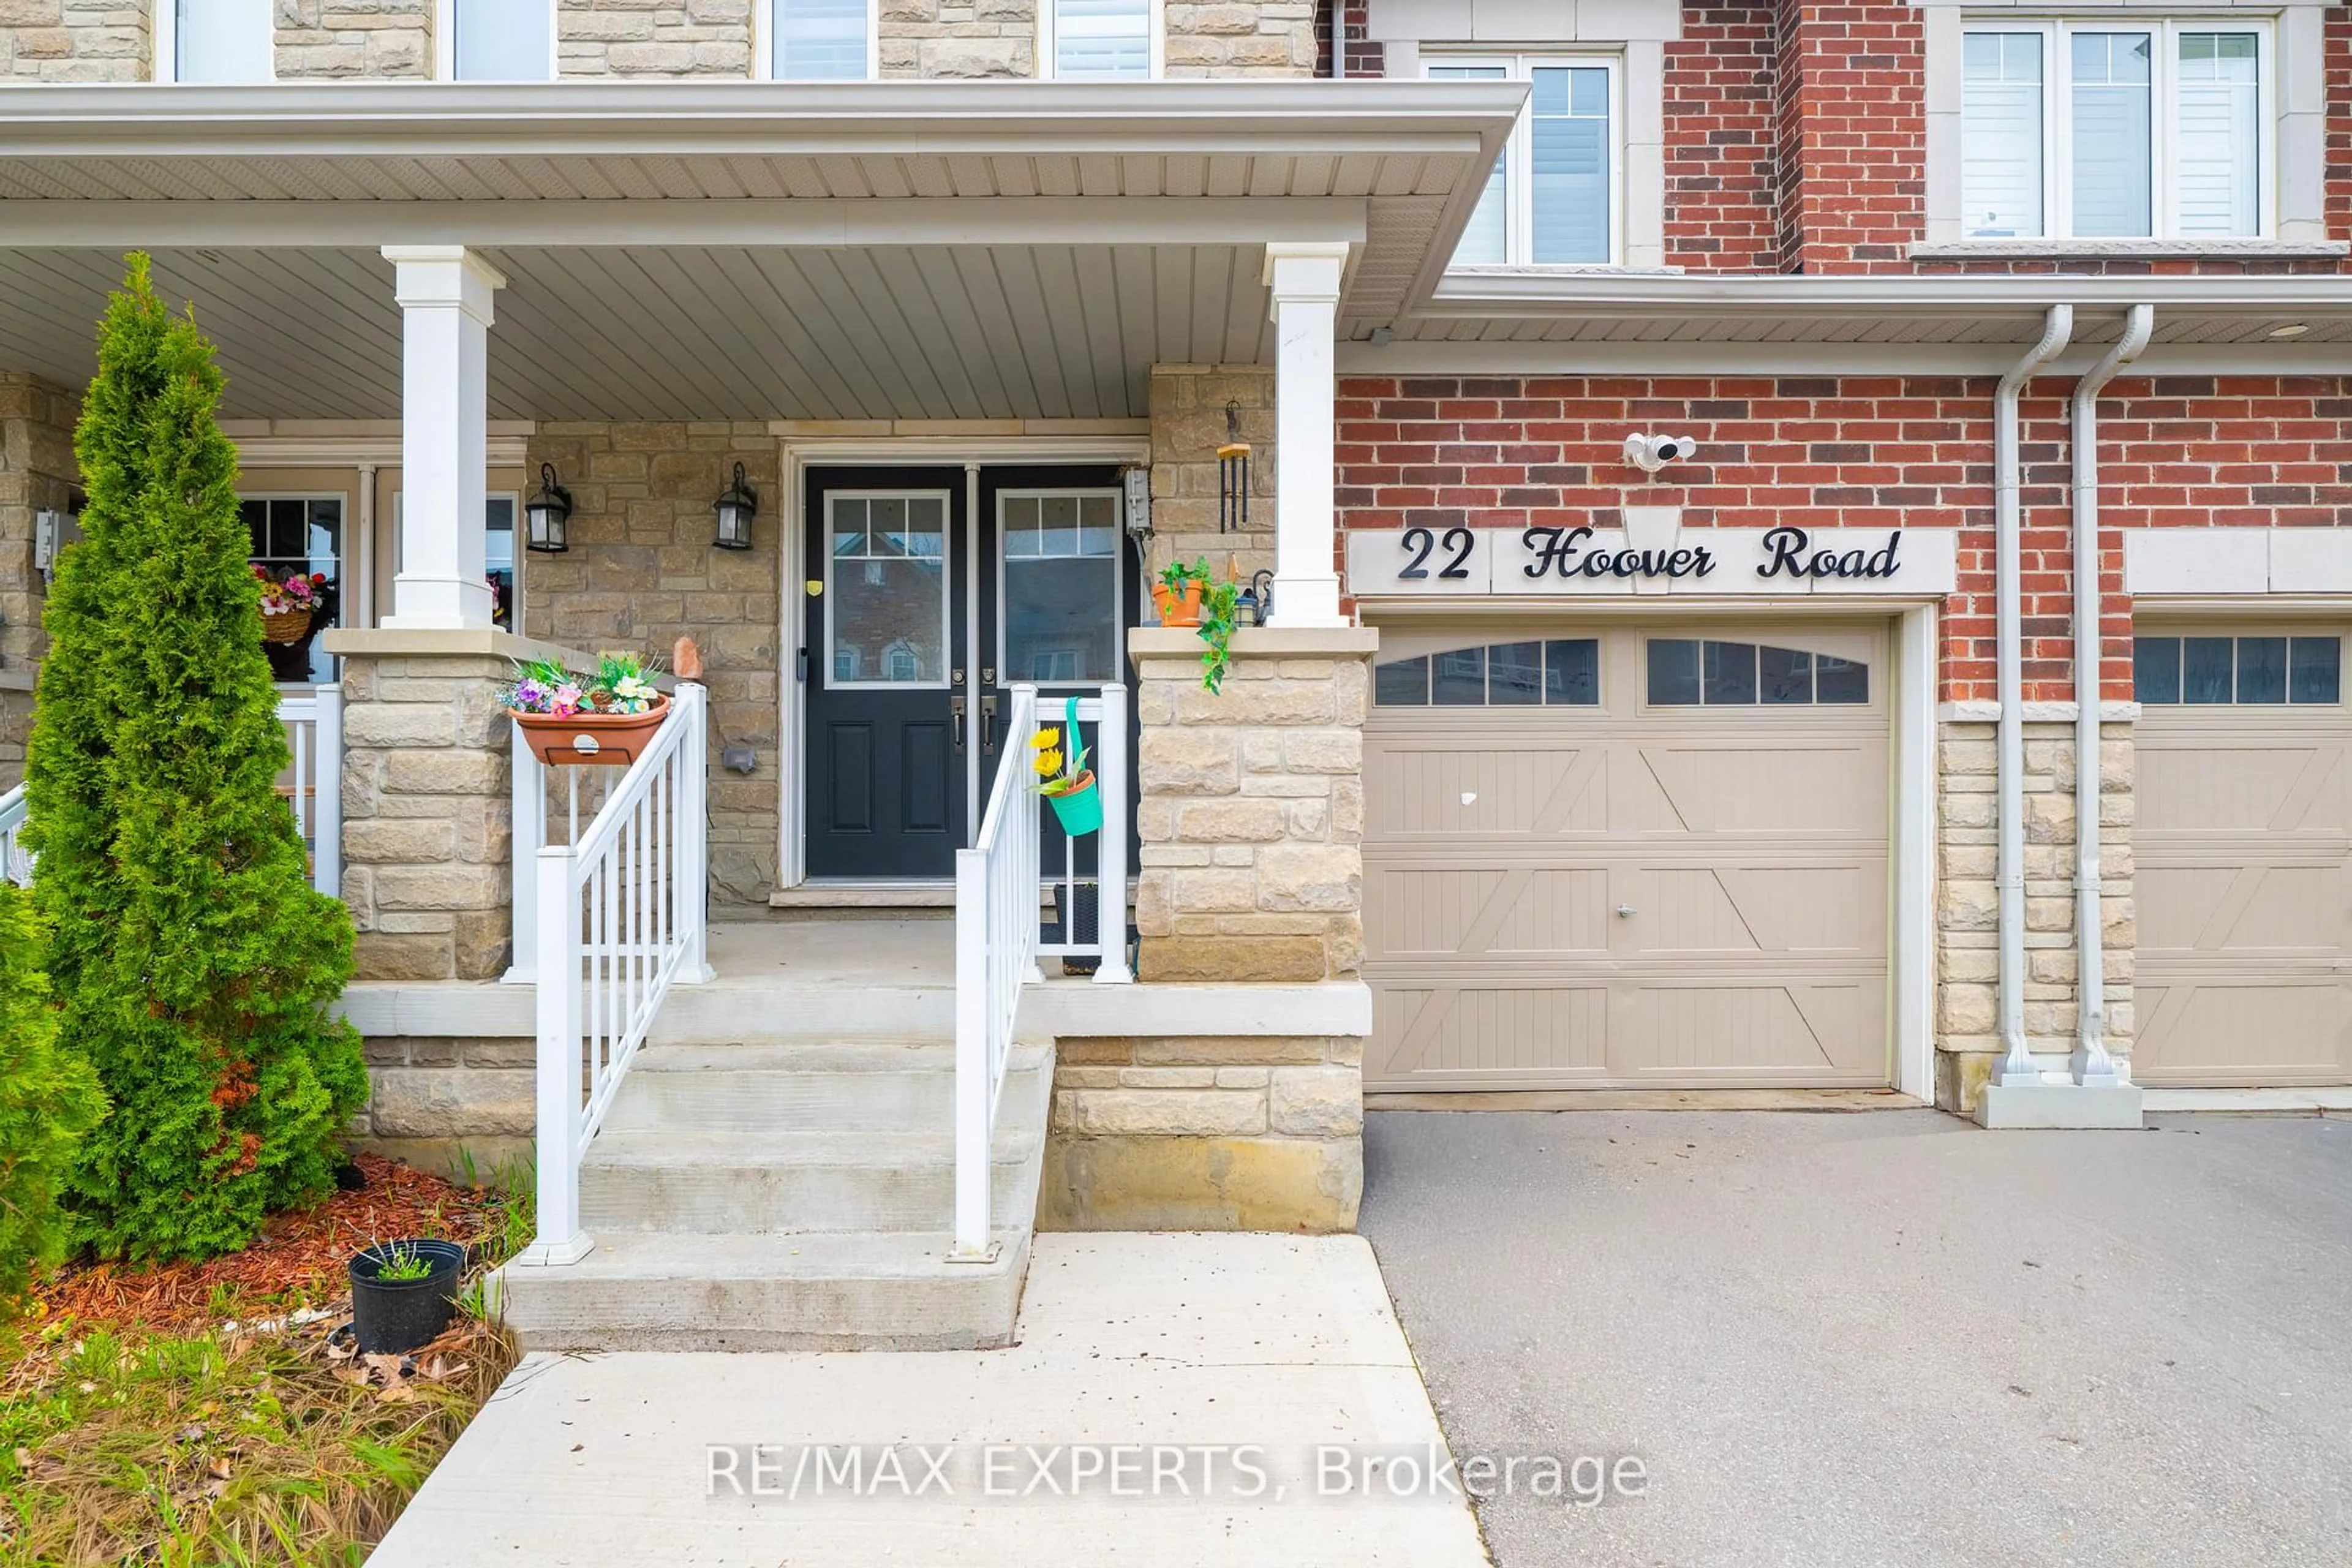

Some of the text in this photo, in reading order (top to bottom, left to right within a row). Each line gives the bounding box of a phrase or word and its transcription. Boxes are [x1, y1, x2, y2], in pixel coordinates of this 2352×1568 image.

[1398, 526, 1901, 579] 22 Hoover Road
